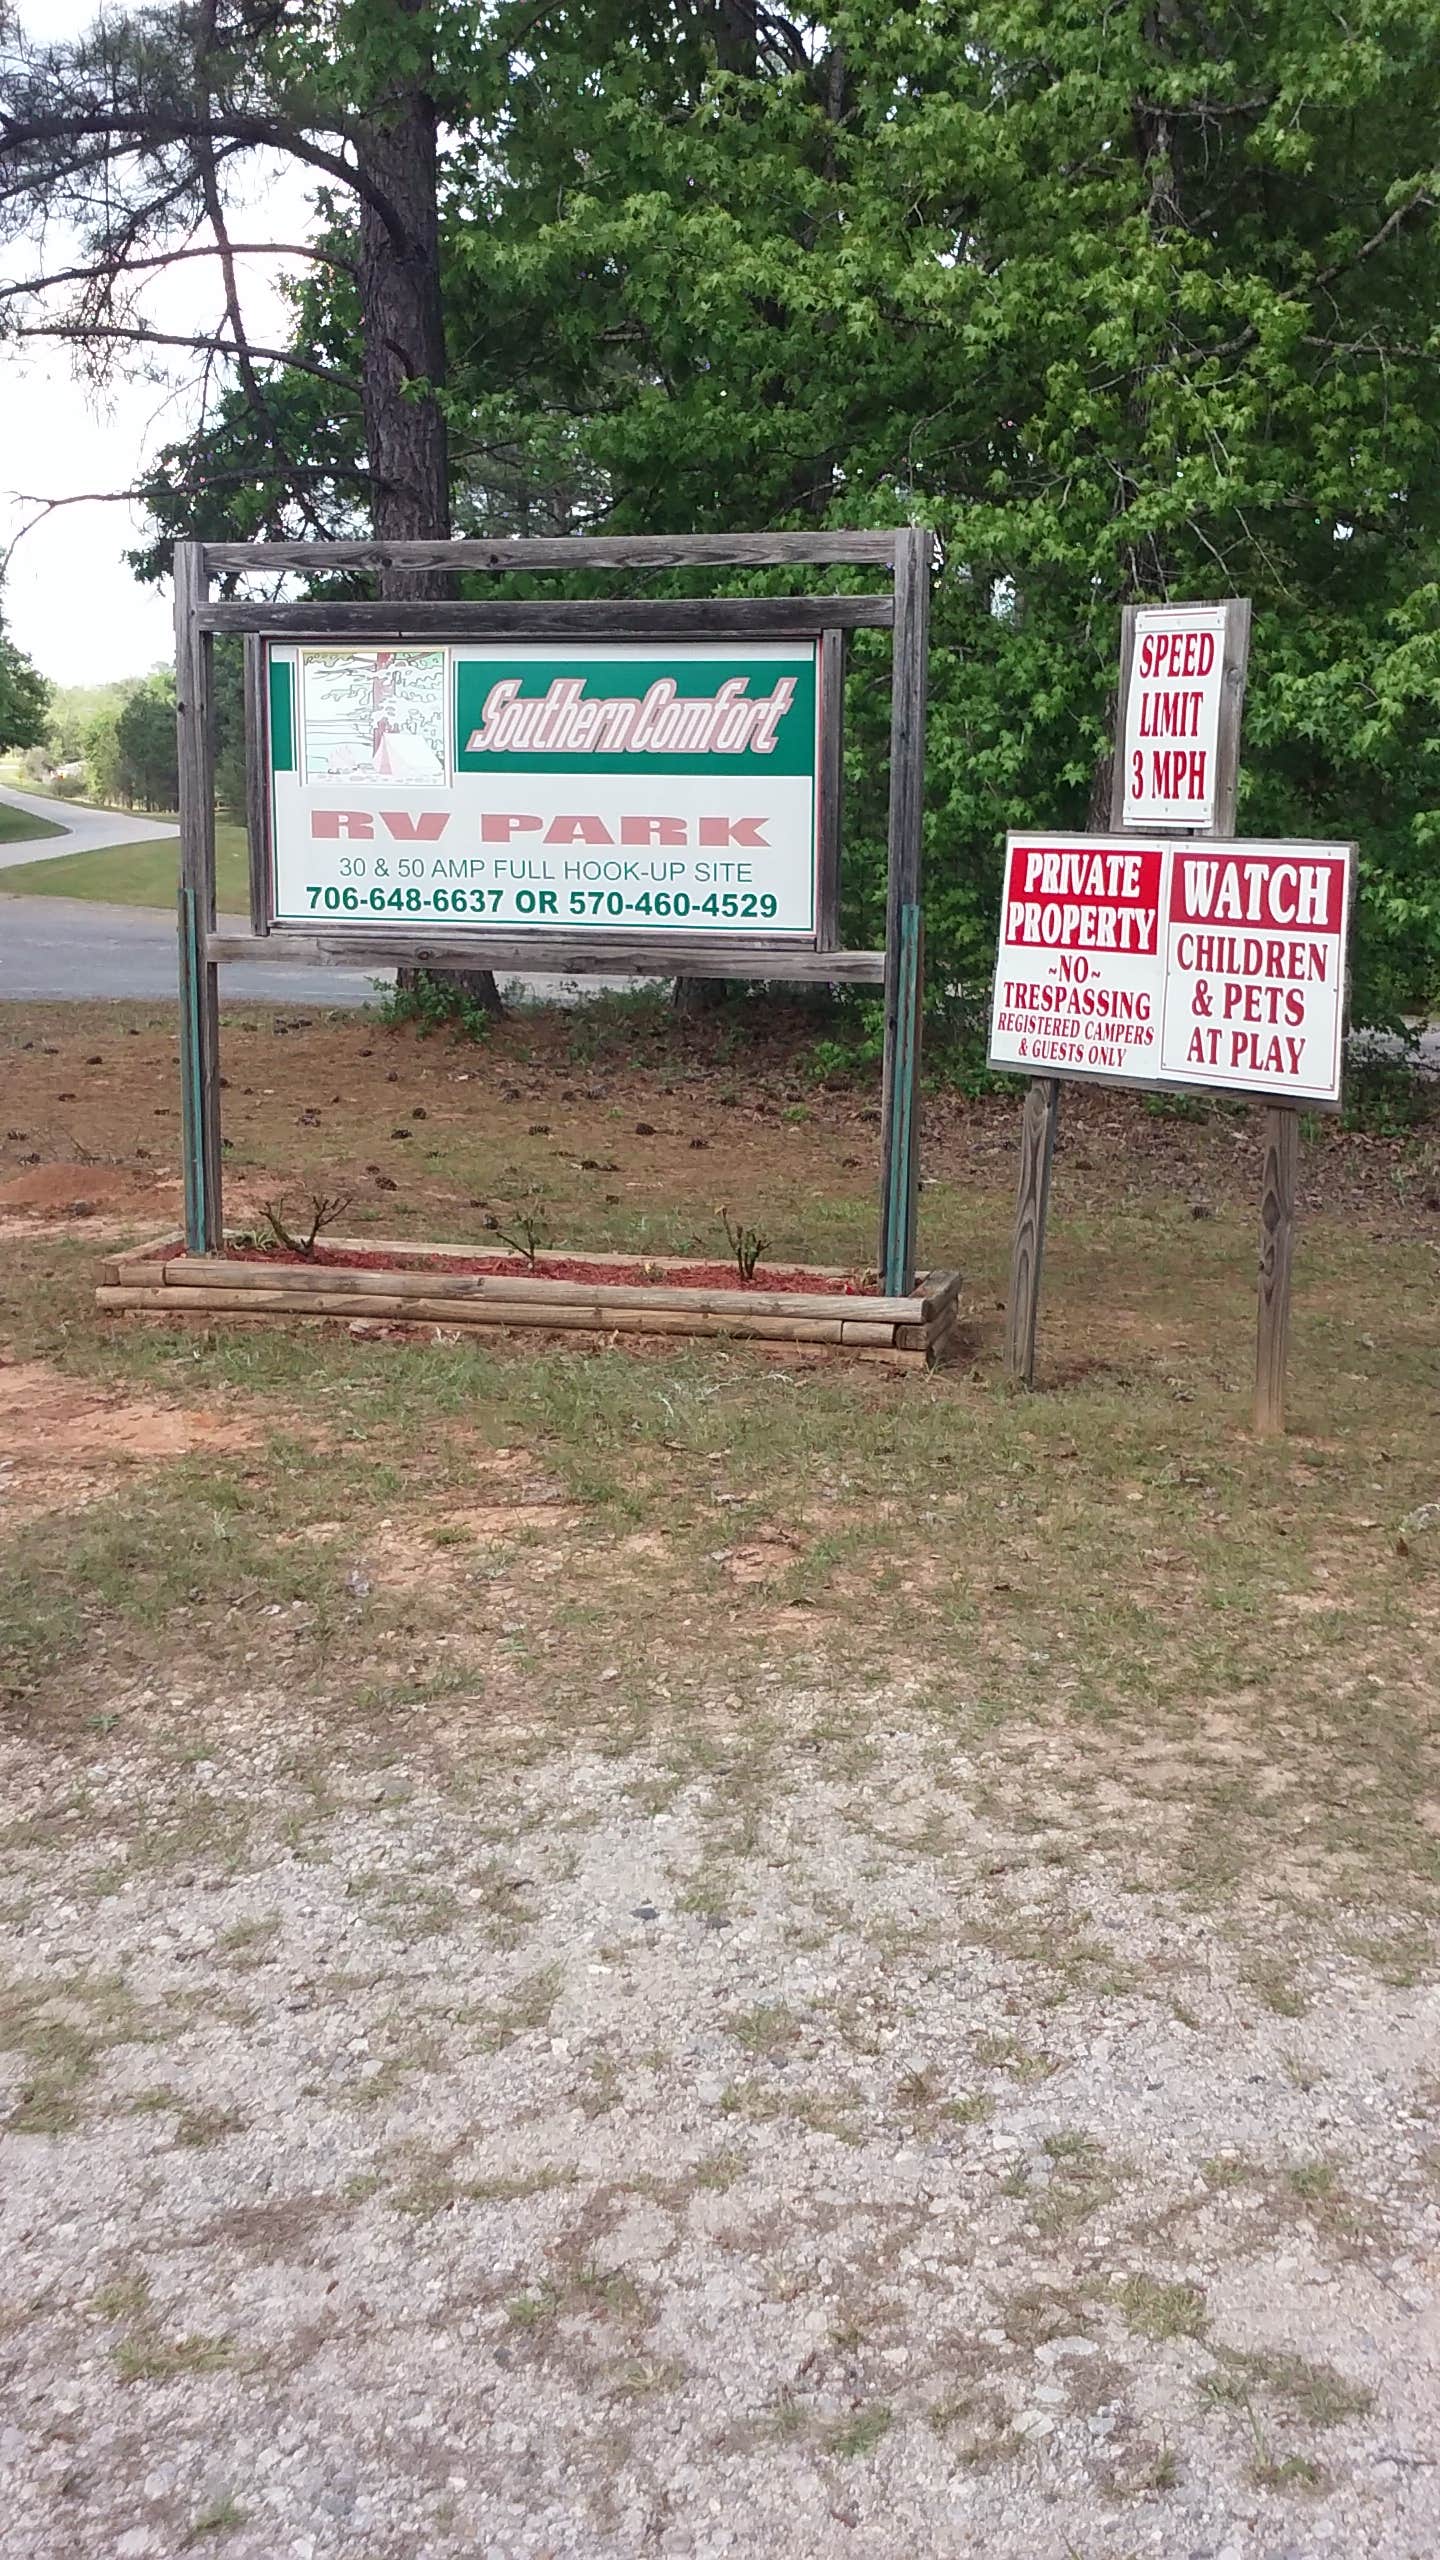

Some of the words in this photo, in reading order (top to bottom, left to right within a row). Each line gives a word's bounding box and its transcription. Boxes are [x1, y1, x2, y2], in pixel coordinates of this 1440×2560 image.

[1140, 632, 1215, 679] SPEED
[466, 678, 641, 753] Southern
[631, 677, 799, 754] Comfort
[1140, 691, 1204, 738] LIMIT
[1132, 750, 1144, 800] 3
[1151, 750, 1206, 800] MPH
[311, 810, 451, 841] RV
[482, 813, 771, 847] PARK
[339, 858, 366, 877] 30
[374, 859, 390, 878] &
[398, 859, 425, 879] 50
[431, 859, 485, 880] AMP
[494, 860, 555, 880] FULL
[564, 861, 686, 881] HOOK-UP
[695, 862, 753, 882] SITE
[1024, 853, 1142, 898] PRIVATE
[1182, 860, 1332, 925] WATCH
[306, 886, 504, 914] 706-648-6637
[516, 890, 559, 915] OR
[569, 890, 778, 918] 570-460-4529
[1007, 901, 1156, 950] PROPERTY
[1177, 933, 1328, 983] CHILDREN
[1003, 982, 1151, 1021] TRESPASSING
[1192, 979, 1212, 1017] &
[1223, 983, 1305, 1026] PETS
[997, 1012, 1081, 1038] REGISTERED
[1084, 1021, 1154, 1046] CAMPERS
[1187, 1027, 1223, 1065] AT
[1232, 1031, 1306, 1074] PLAY
[1018, 1039, 1029, 1057] &
[1032, 1041, 1085, 1064] GUESTS
[1088, 1044, 1127, 1067] ONLY
